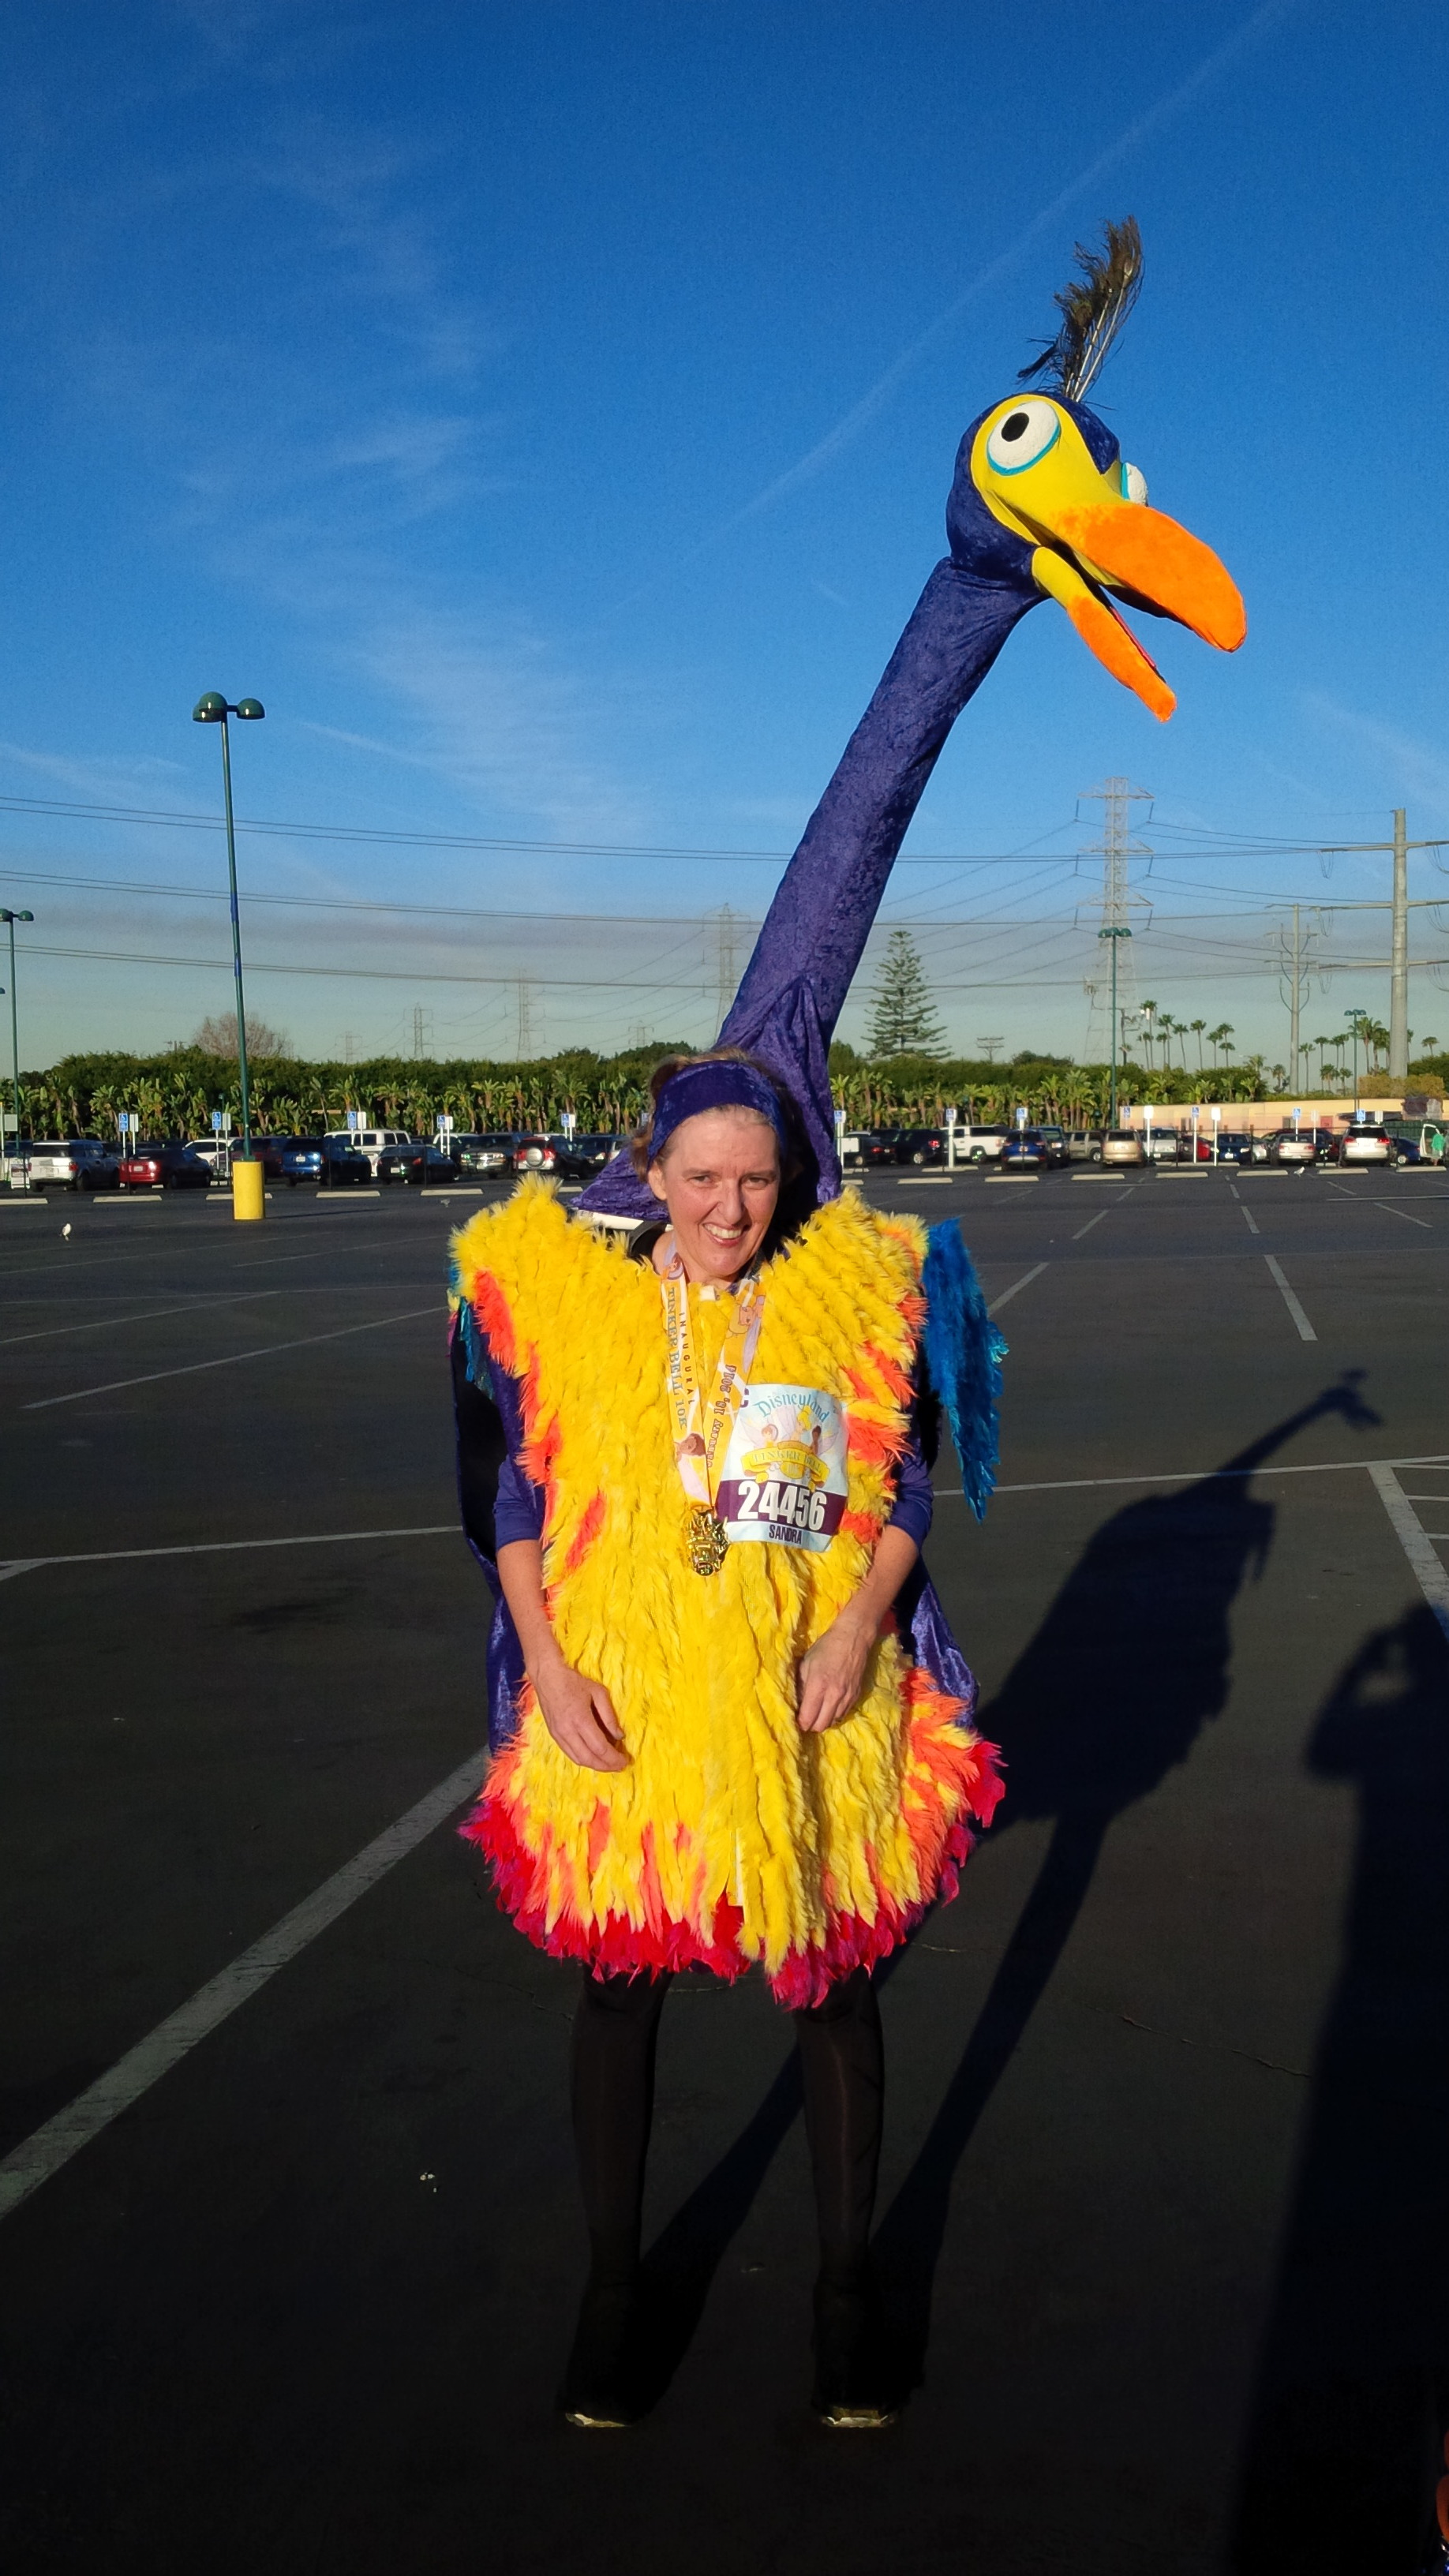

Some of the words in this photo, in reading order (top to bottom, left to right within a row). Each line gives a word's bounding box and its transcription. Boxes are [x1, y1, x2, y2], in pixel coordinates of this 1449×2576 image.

[668, 1287, 679, 1347] TINKER
[668, 1350, 683, 1395] BELL
[679, 1312, 695, 1405] INAUGURAL
[719, 1364, 736, 1393] 2014
[675, 1399, 687, 1430] 10K
[713, 1398, 730, 1415] 18,
[753, 1394, 829, 1423] Disneyland
[738, 1481, 827, 1530] 24456
[768, 1524, 802, 1544] SANDRA
